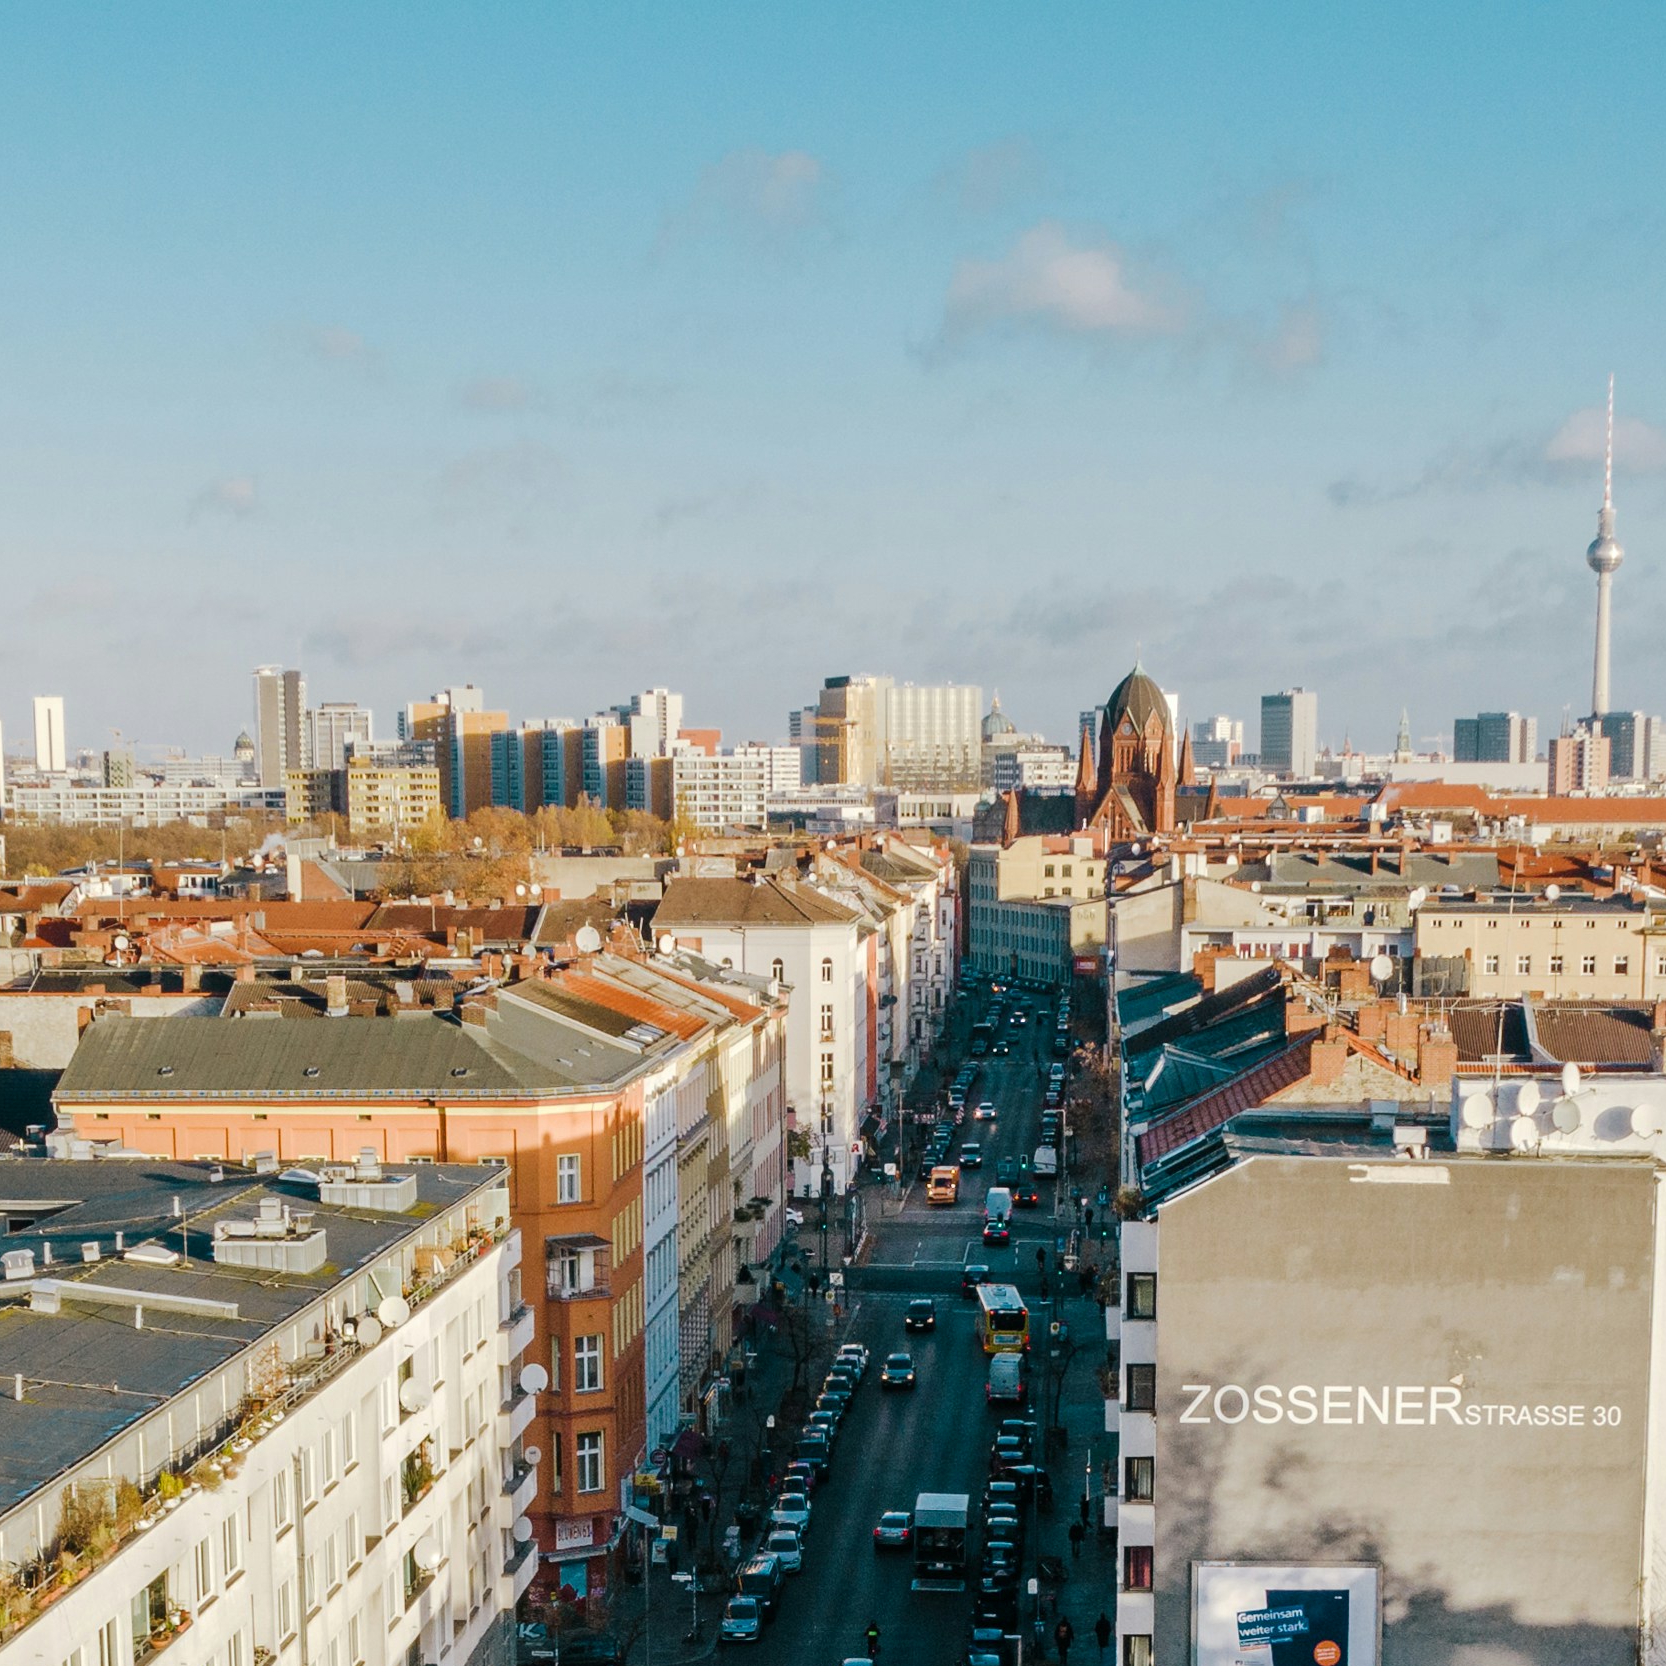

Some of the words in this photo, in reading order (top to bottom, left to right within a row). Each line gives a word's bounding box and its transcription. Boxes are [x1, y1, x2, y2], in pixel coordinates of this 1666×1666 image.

[1179, 1385, 1463, 1425] ZOSSENER
[1464, 1405, 1585, 1426] STRASSE
[1592, 1406, 1622, 1426] 30
[1238, 1608, 1303, 1624] Gemeinsam
[1239, 1625, 1274, 1637] weiter
[1278, 1620, 1308, 1633] stark.
